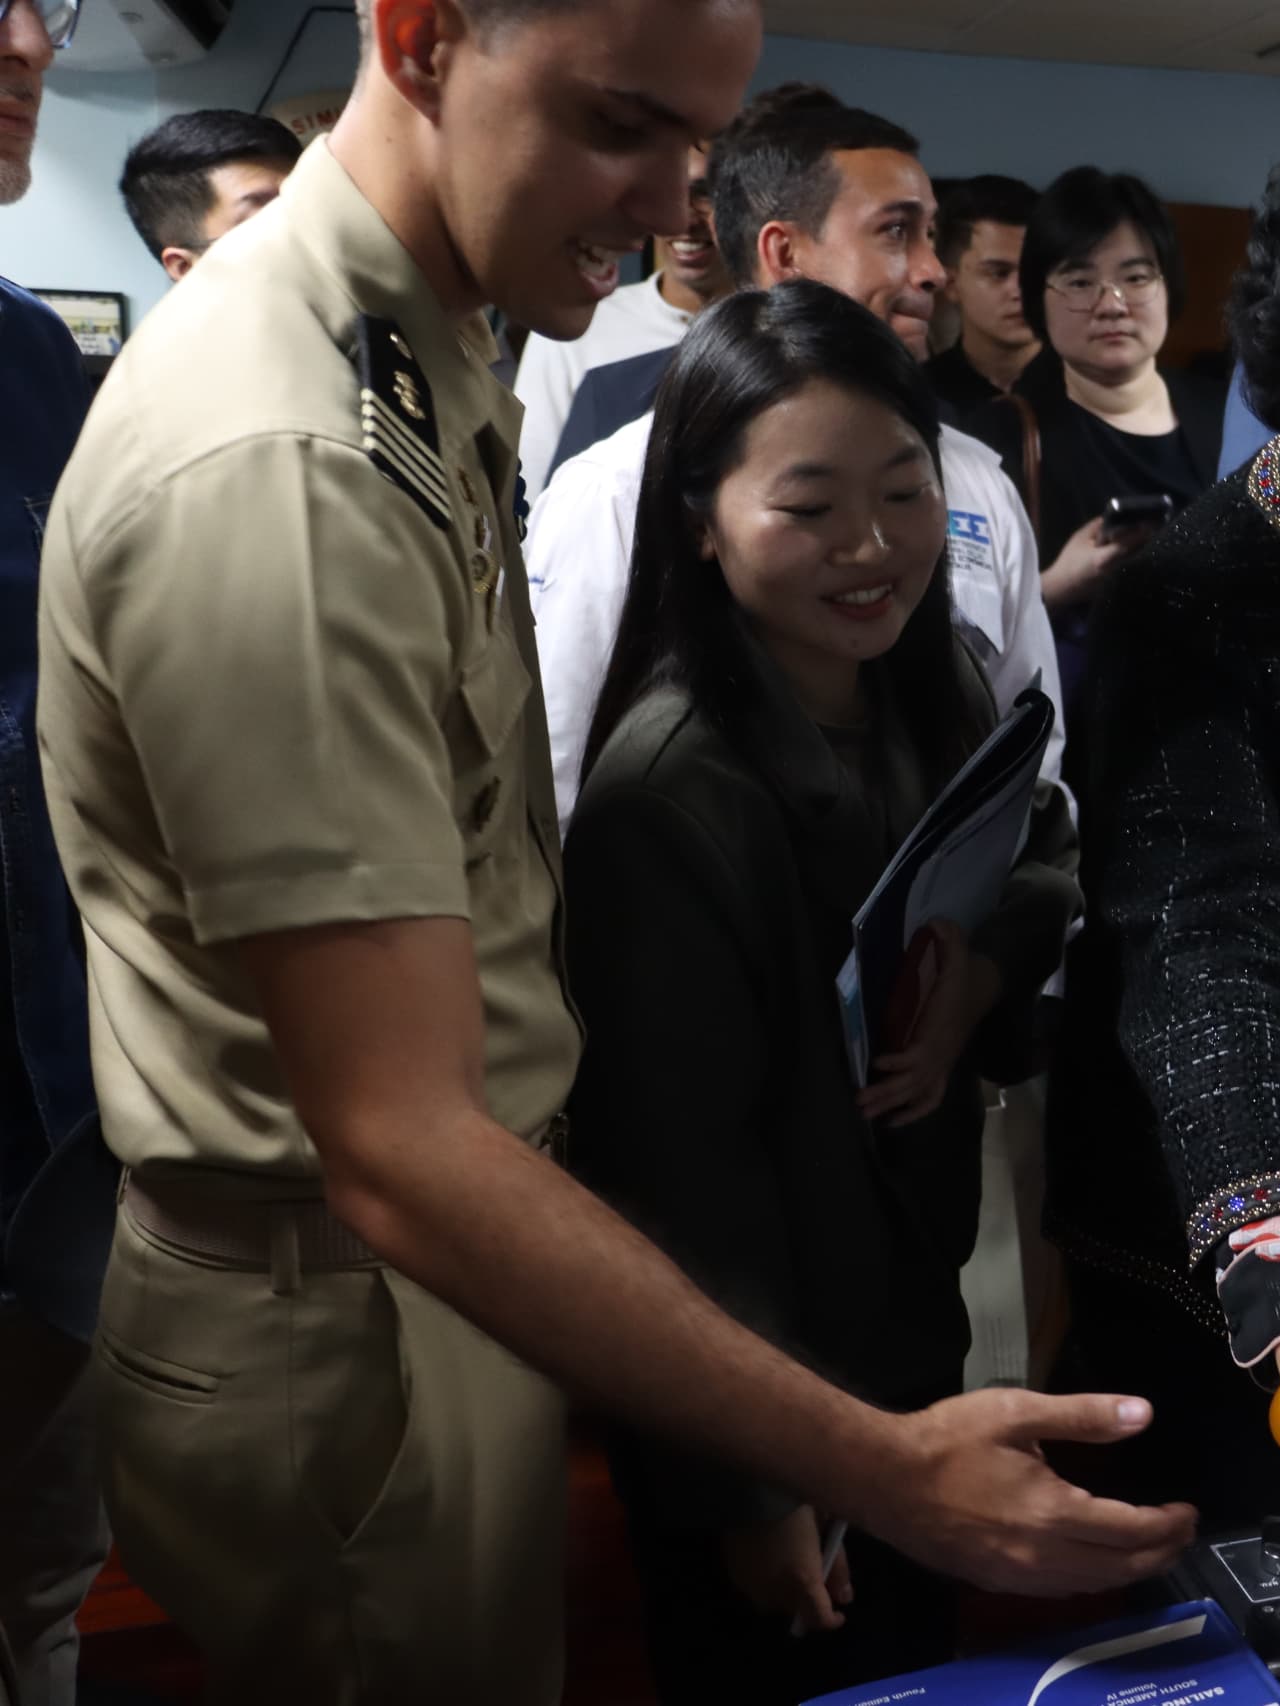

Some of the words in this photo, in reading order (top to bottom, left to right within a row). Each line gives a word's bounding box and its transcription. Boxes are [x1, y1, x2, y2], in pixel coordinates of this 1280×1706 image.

[891, 1687, 926, 1700] Fourth
[1119, 1682, 1158, 1697] Volume
[1159, 1679, 1198, 1695] SOUTH
[1107, 1690, 1158, 1706] AMERICA
